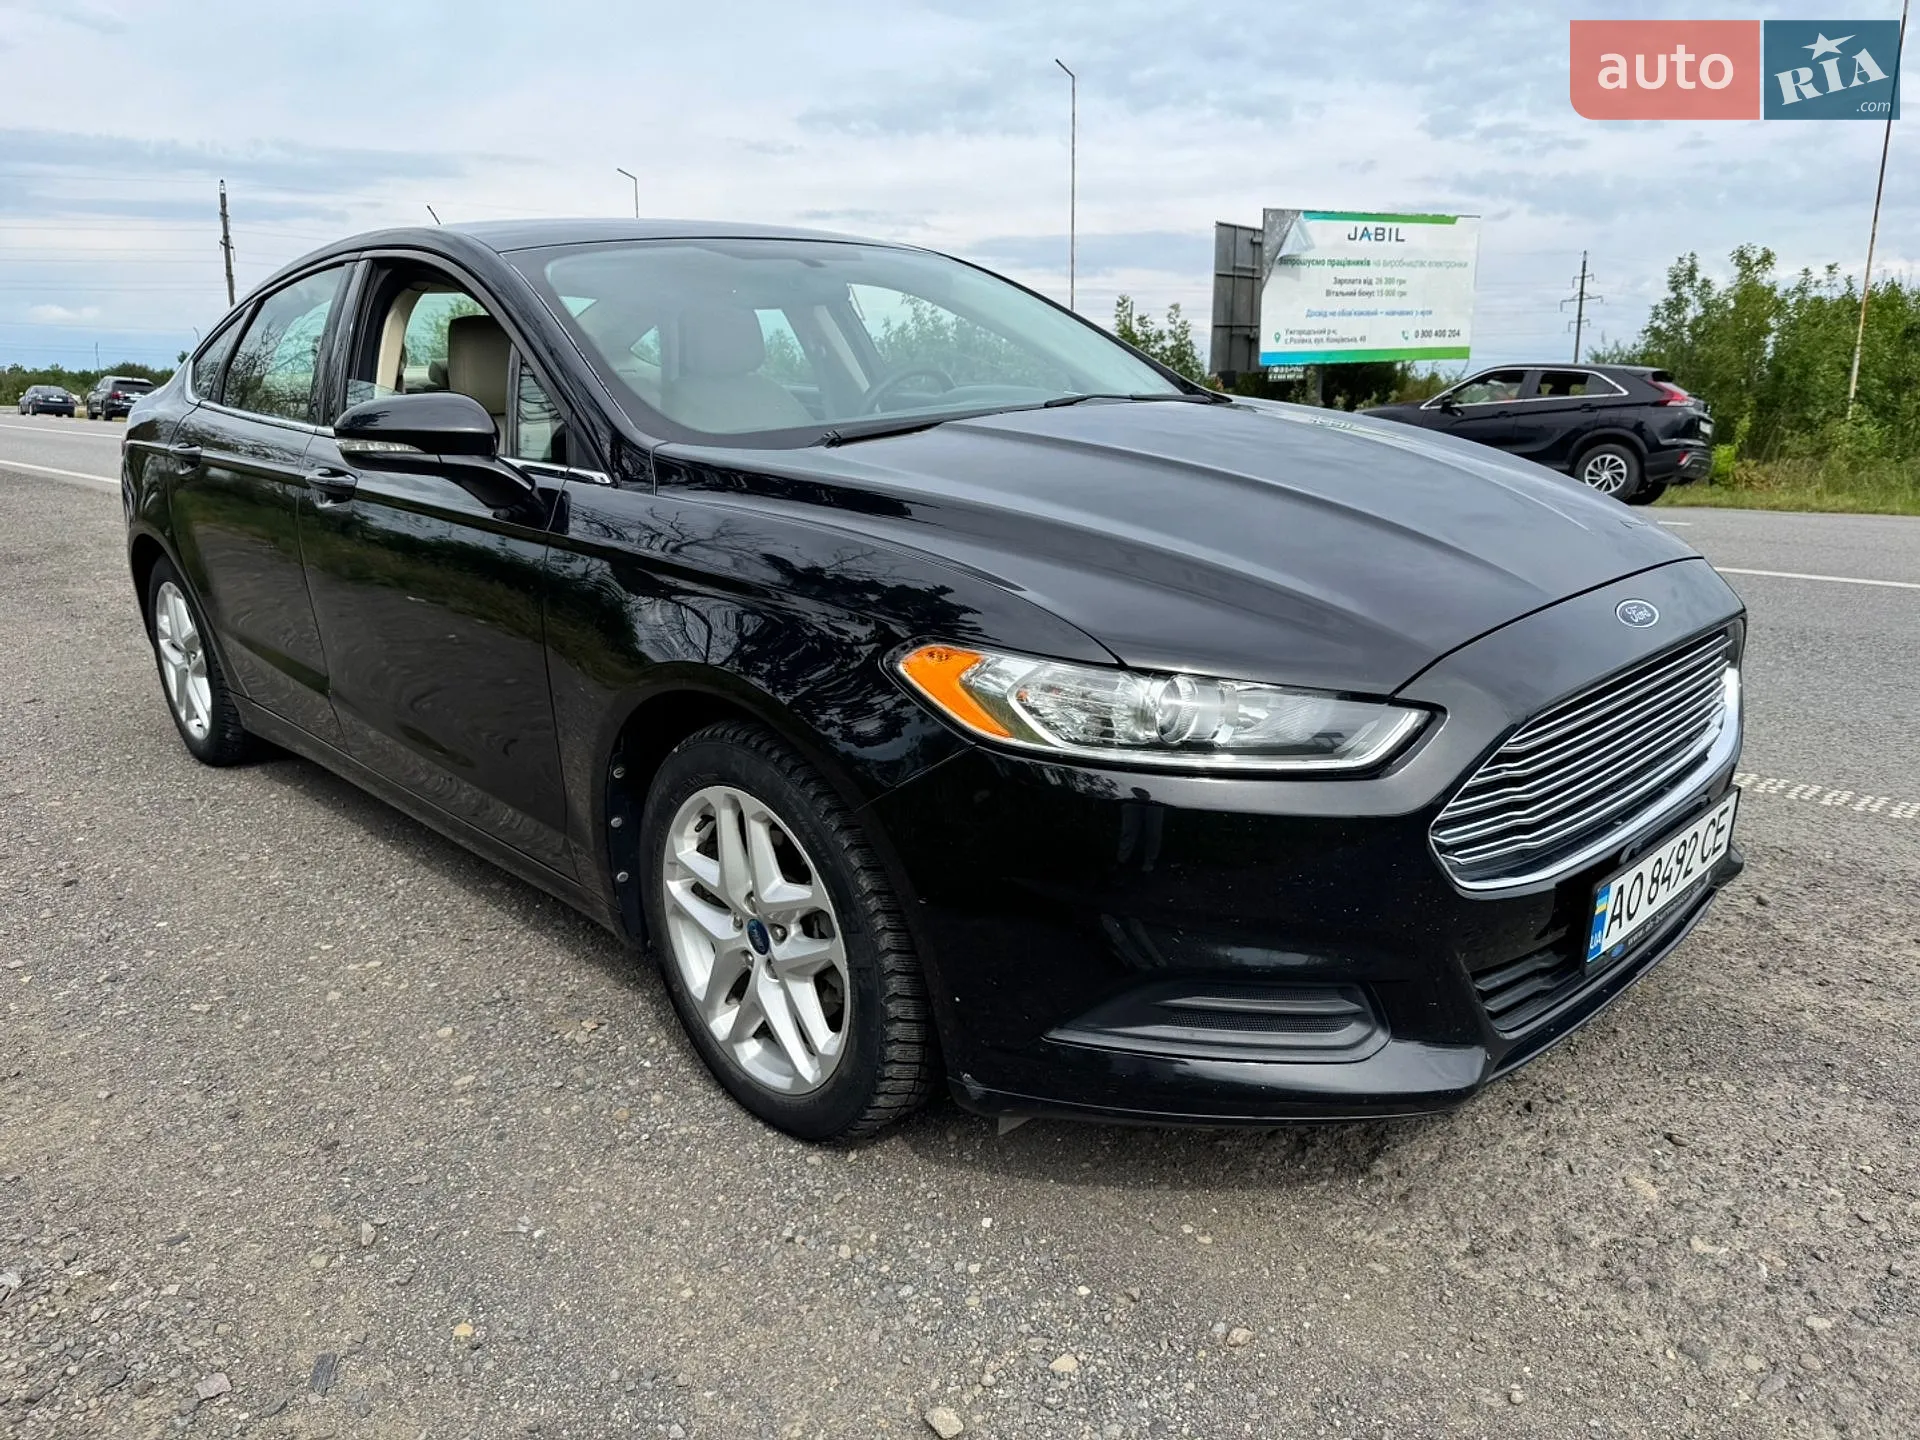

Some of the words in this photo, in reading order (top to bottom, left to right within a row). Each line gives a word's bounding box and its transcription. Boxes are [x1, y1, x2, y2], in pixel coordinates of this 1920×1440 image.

[1347, 226, 1406, 242] JABIL
[1605, 871, 1643, 938] AO
[1647, 831, 1699, 905] 8492
[1701, 806, 1729, 864] CE
